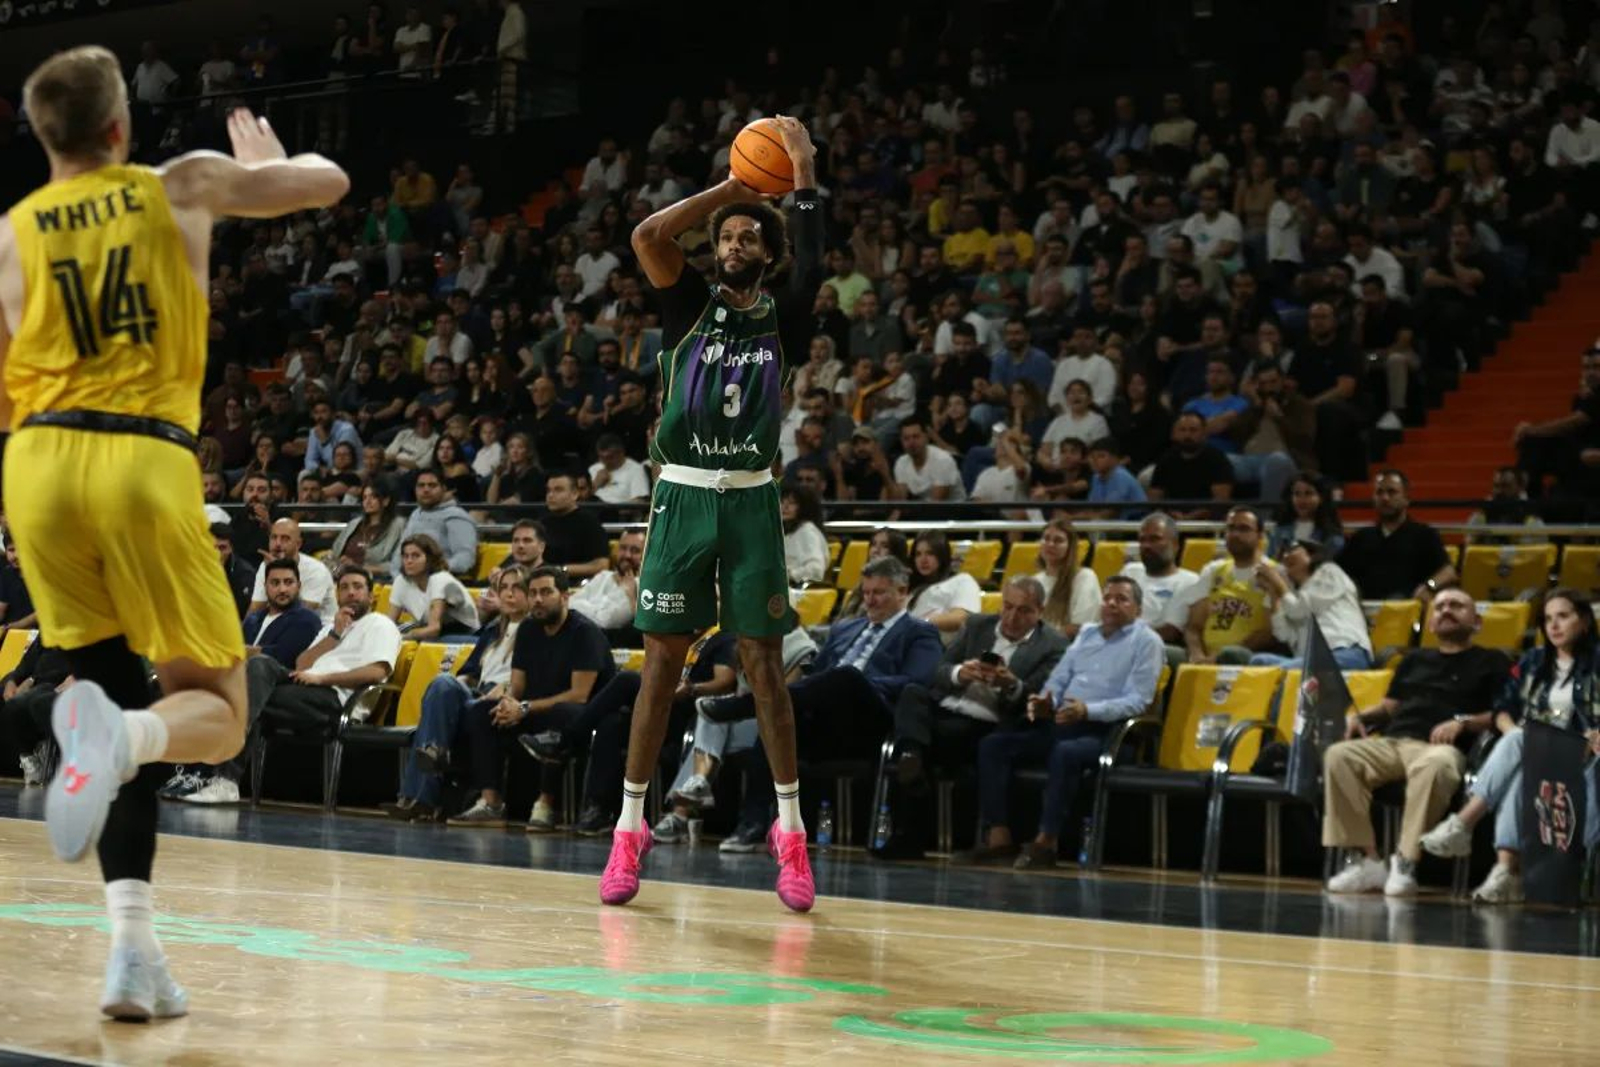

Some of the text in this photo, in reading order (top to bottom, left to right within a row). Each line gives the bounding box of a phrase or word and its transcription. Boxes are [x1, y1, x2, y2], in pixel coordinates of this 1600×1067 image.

[35, 180, 146, 233] WHITE
[50, 244, 157, 357] 14
[723, 347, 773, 367] Unicaja
[723, 383, 741, 418] 3
[657, 592, 685, 601] COSTA
